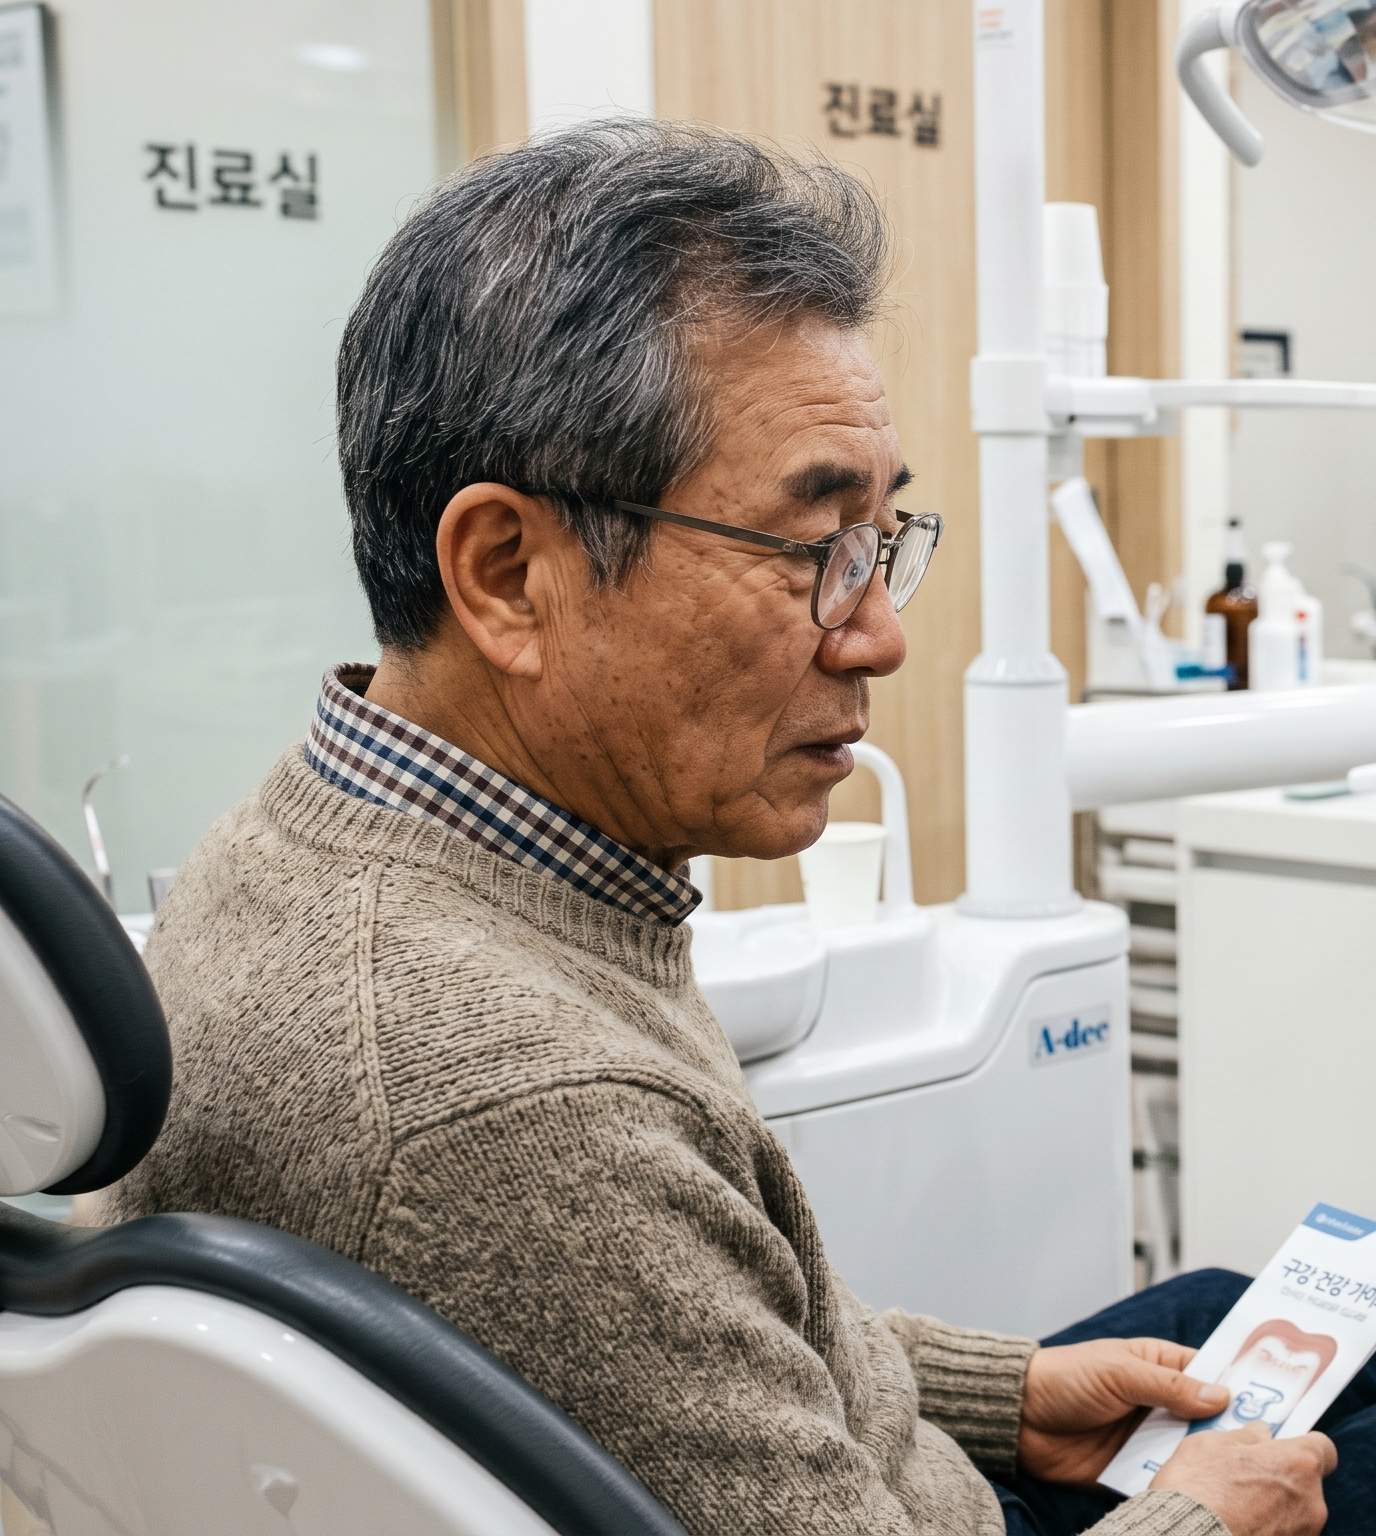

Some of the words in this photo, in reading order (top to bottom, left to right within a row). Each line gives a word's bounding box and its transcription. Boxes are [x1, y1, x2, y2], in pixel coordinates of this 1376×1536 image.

[821, 82, 941, 148] 진료실
[139, 142, 320, 221] 진료실
[1283, 1258, 1318, 1286] 구강
[1315, 1271, 1351, 1297] 건강
